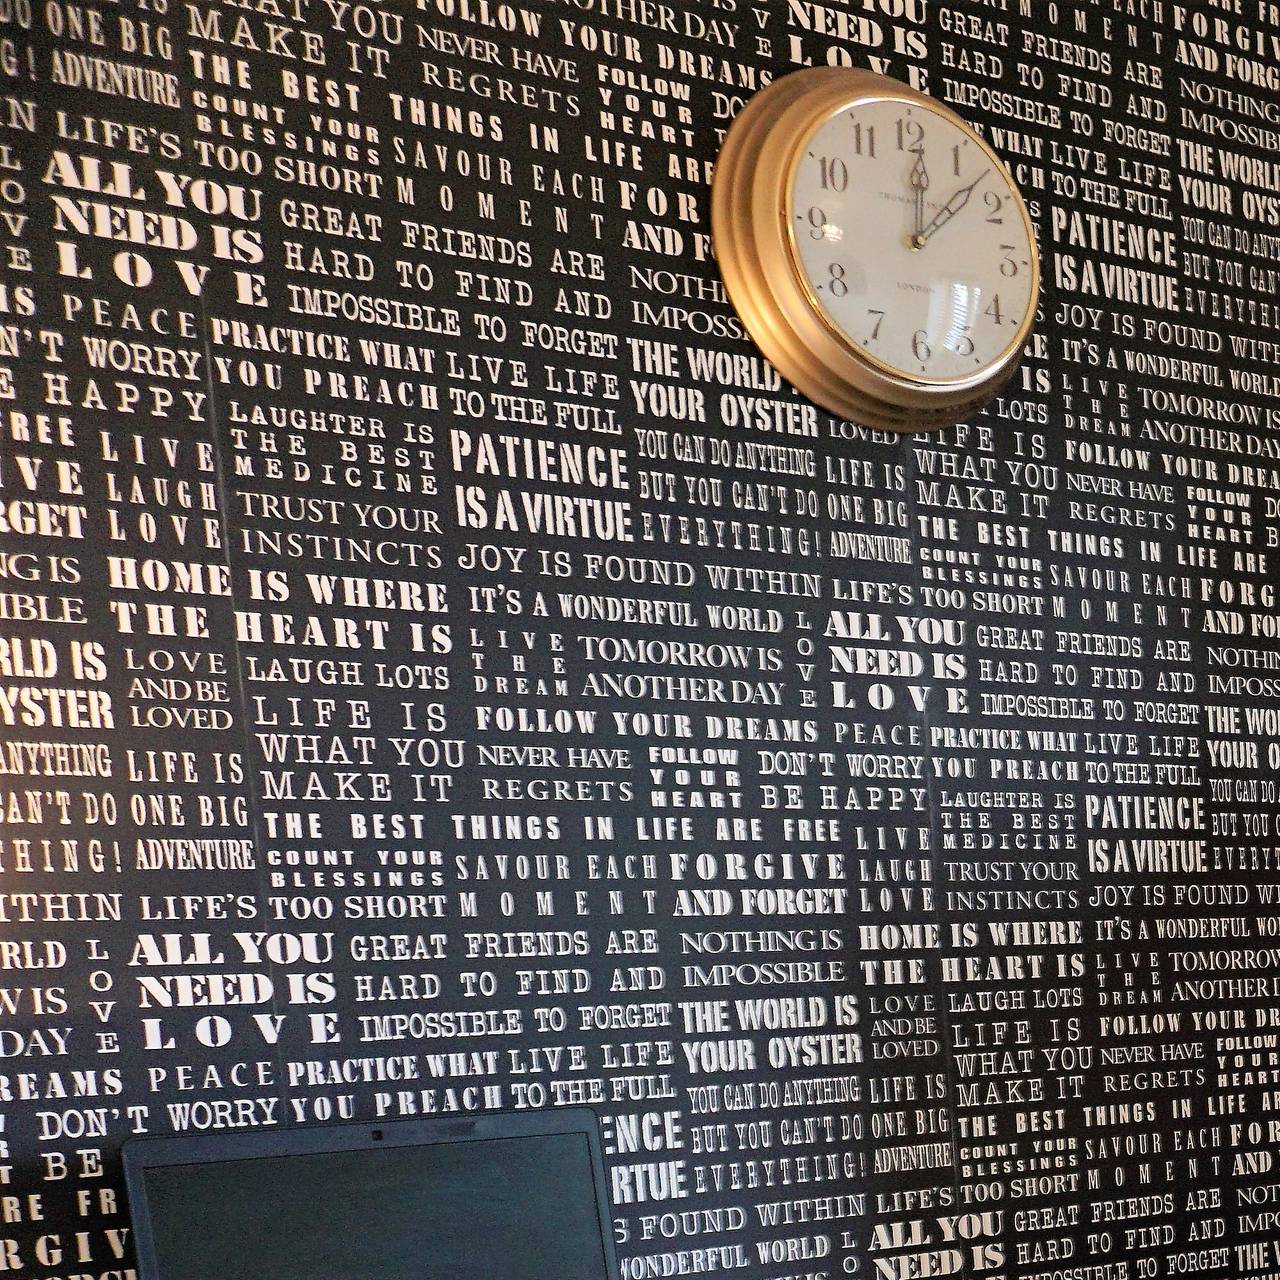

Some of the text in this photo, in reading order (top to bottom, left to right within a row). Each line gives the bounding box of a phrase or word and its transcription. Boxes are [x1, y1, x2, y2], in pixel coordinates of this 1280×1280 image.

[185, 4, 390, 79] MAKE IT
[1175, 39, 1218, 72] AND
[53, 50, 180, 108] ADVENTURE
[598, 64, 690, 105] FOLLOW
[599, 89, 692, 130] YOUR
[600, 106, 694, 147] HEART
[853, 118, 960, 177] 11 12 1
[42, 151, 262, 221] ALL YOU
[818, 156, 848, 192] 10
[984, 191, 1003, 225] 2
[1178, 175, 1232, 215] YOUR
[51, 196, 263, 263] NEED IS
[281, 199, 532, 267] GREAT FRIENDS
[808, 206, 1018, 278] 9 3
[1052, 206, 1176, 267] PATIENCE
[56, 240, 268, 309] LOVE
[828, 262, 1004, 325] 8 4
[63, 295, 196, 338] PEACE
[287, 285, 460, 336] IMPOSSIBLE
[211, 317, 435, 373] PRACTICE WHAT
[867, 308, 885, 340] 7
[911, 329, 931, 361] 6
[1143, 319, 1222, 352] FOUND
[43, 373, 206, 421] HAPPY
[630, 380, 818, 437] YOUR OYSTER
[230, 401, 434, 444] LAUGHTER IS
[235, 456, 437, 495] MEDICINE
[236, 491, 442, 534] TRUST YOUR
[640, 511, 824, 559] EVERYTHING!
[1048, 530, 1123, 558] THINGS
[107, 557, 448, 612] HOME IS WHERE
[110, 602, 452, 653] THE HEART IS
[558, 594, 783, 632] WONDERFUL WORLD
[1202, 610, 1244, 634] AND
[246, 657, 449, 690] LAUGH LOTS
[578, 636, 782, 671] TOMORROW IS
[582, 673, 781, 705] ANOTHER DAY
[706, 716, 818, 742] DREAMS
[255, 733, 465, 767] WHAT YOU
[1207, 740, 1258, 768] YOUR
[268, 851, 442, 865] COUNT YOUR
[272, 872, 443, 887] BLESSINGS
[345, 895, 446, 918] SHORT
[1155, 918, 1250, 938] WONDERFUL
[136, 973, 336, 1007] NEED IS
[142, 1013, 340, 1049] LOVE
[1100, 1013, 1180, 1036] FOLLOW
[1192, 1010, 1245, 1030] YOUR
[167, 1098, 278, 1131] WORRY
[962, 1155, 1076, 1177] BLESSINGS
[1090, 1194, 1174, 1223] FRIENDS
